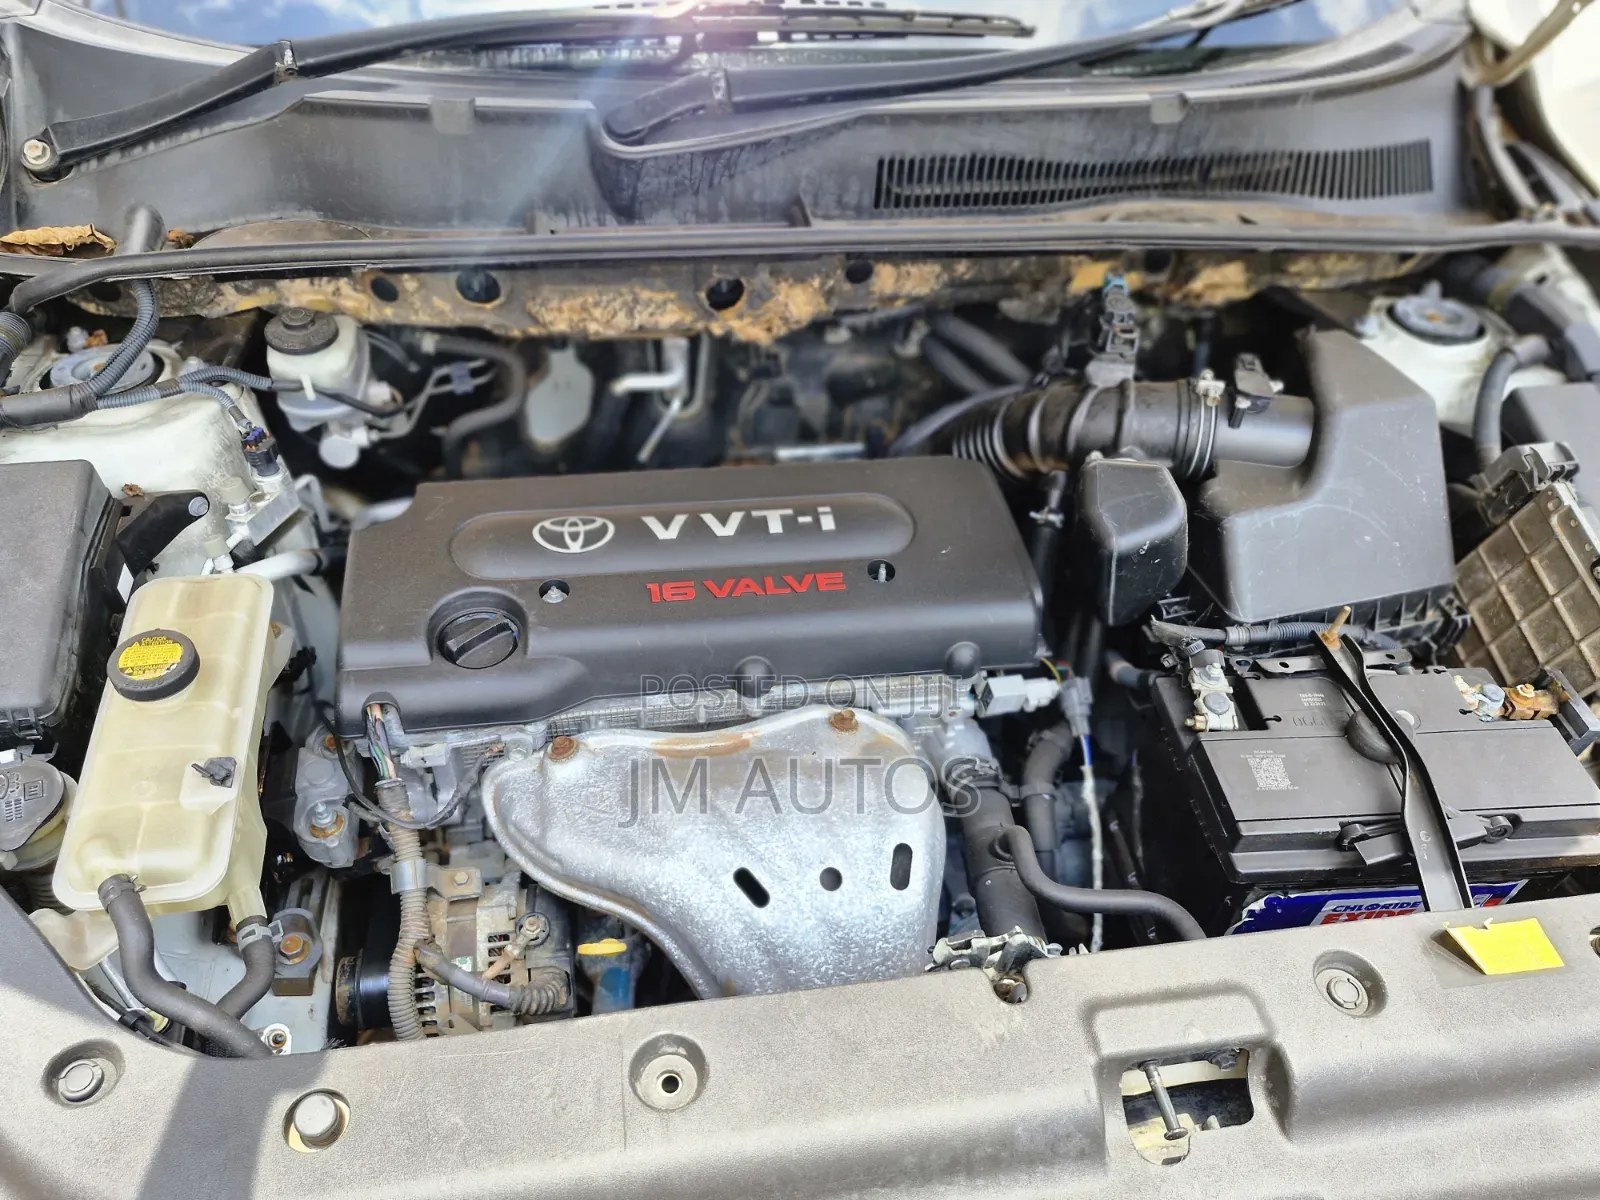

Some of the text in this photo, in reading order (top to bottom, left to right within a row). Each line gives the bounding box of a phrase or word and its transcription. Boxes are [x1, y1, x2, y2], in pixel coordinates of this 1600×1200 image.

[640, 506, 837, 540] VVT-i
[646, 572, 847, 603] 16 VALVE
[1331, 901, 1423, 913] CHLORIDE
